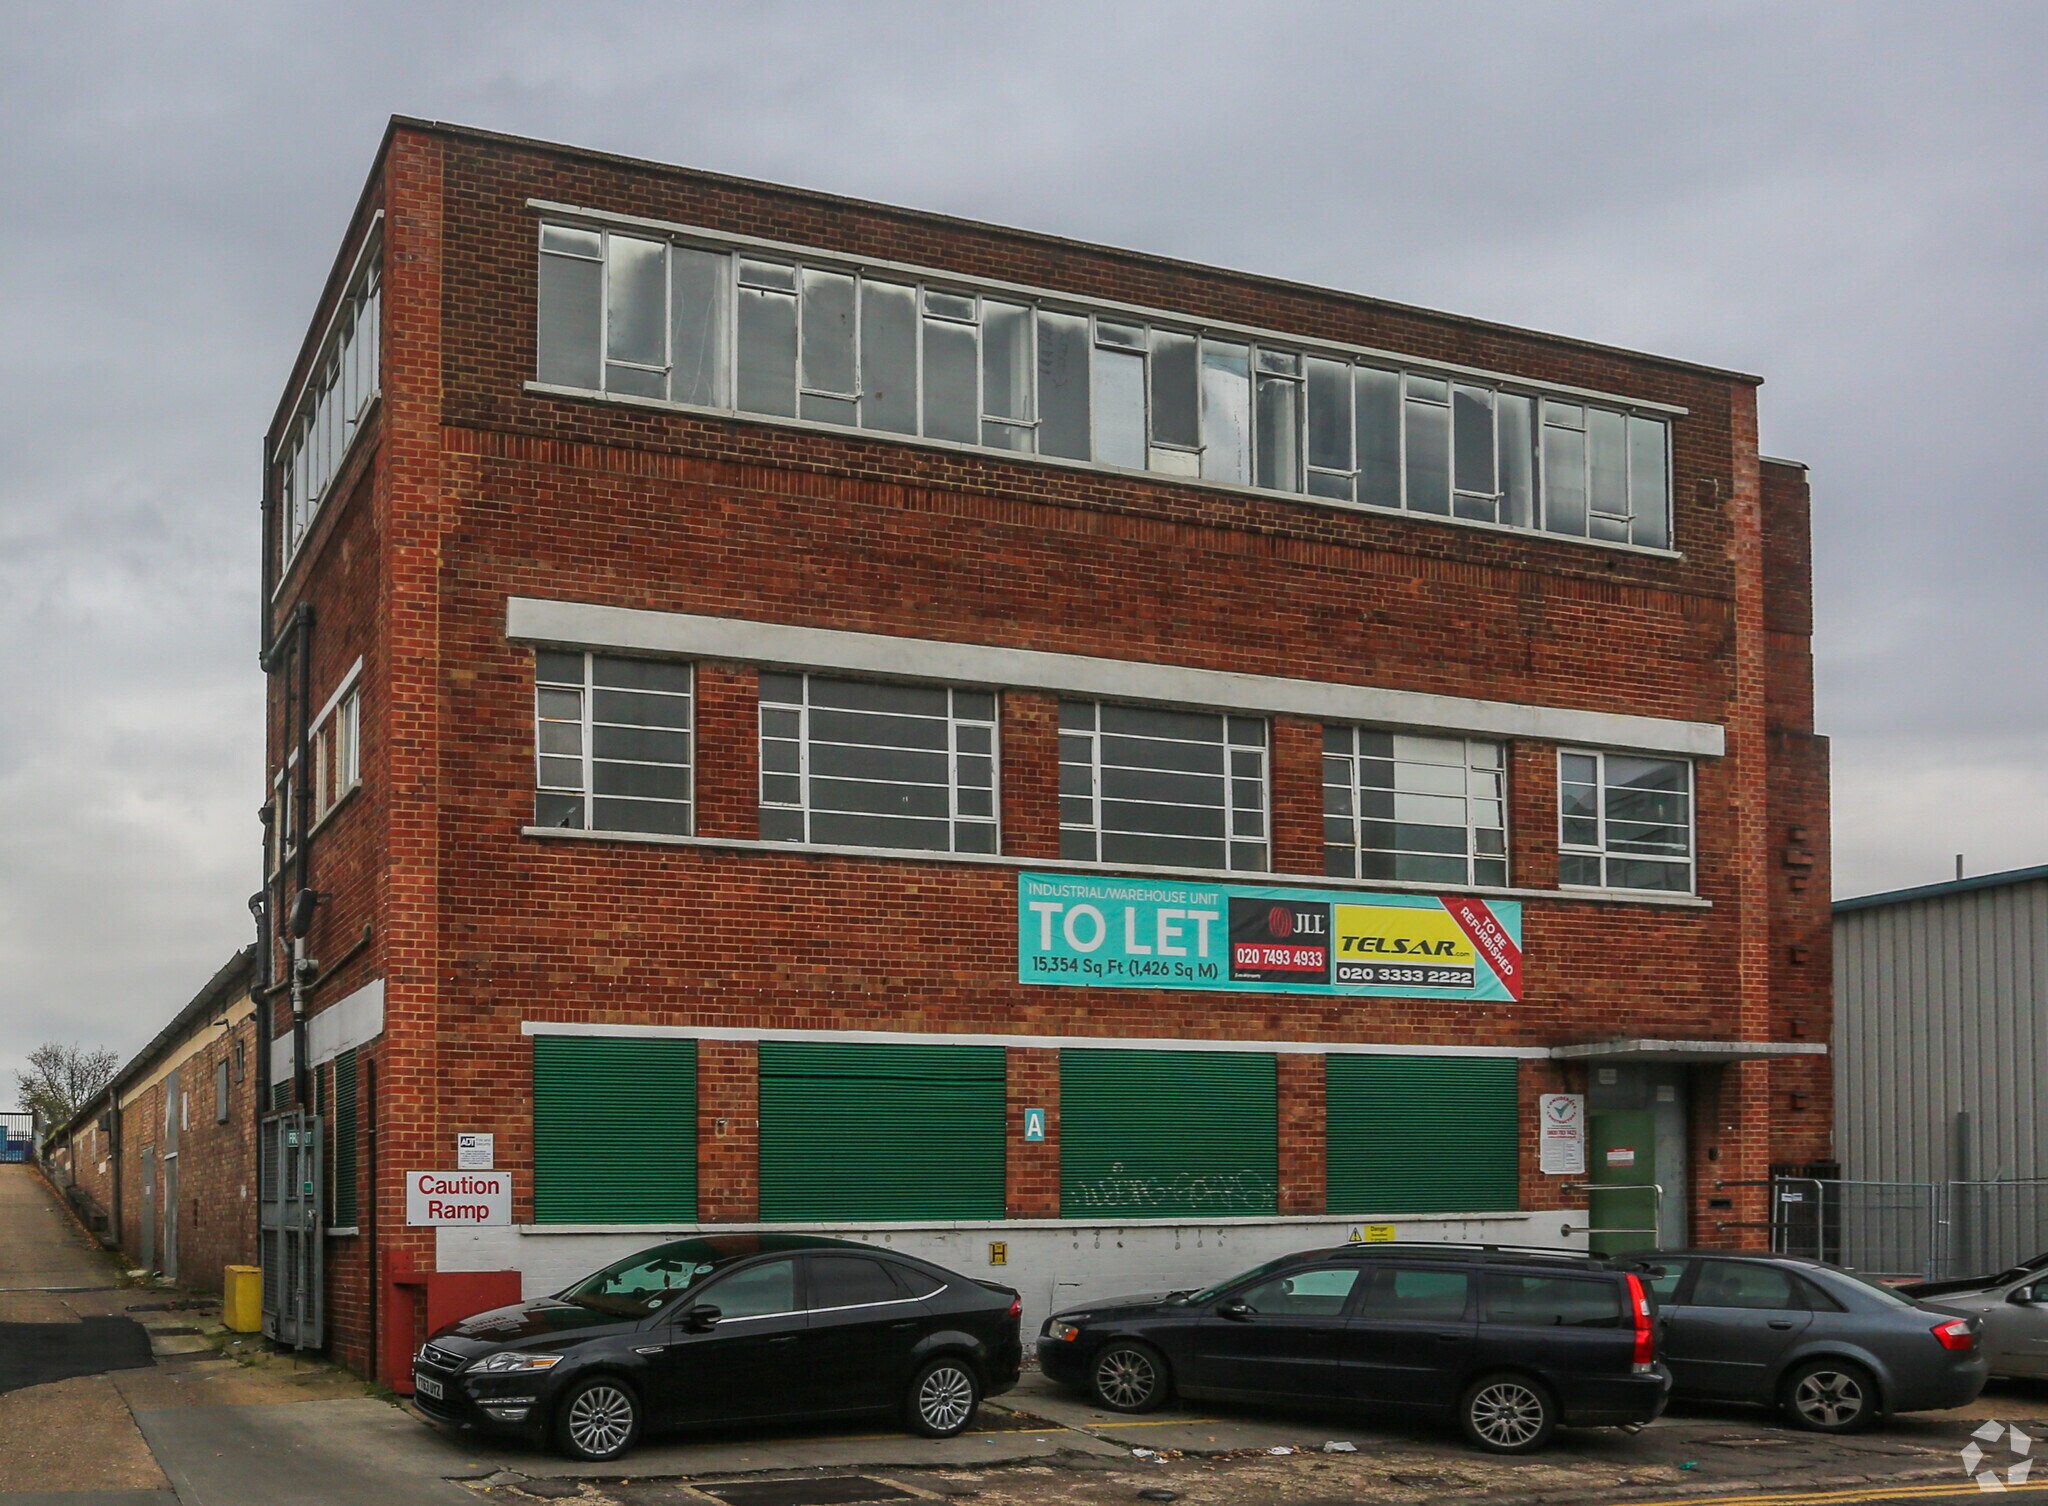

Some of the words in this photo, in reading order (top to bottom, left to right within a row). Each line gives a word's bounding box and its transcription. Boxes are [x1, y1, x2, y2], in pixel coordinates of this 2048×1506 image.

[1028, 882, 1187, 904] INDUSTRIAL/WAREHOUSE
[1190, 892, 1219, 905] UNIT
[1029, 901, 1106, 953] TO
[1124, 906, 1219, 957] LET
[1293, 913, 1325, 934] JLL
[1482, 916, 1496, 934] TO
[1493, 932, 1508, 950] BE
[1460, 906, 1514, 976] REFURBISHED
[1032, 956, 1078, 973] 15,354
[1083, 958, 1102, 977] Sq
[1108, 960, 1123, 974] Ft
[1129, 959, 1170, 977] (1,426
[1174, 962, 1193, 980] Sq
[1199, 963, 1218, 979] M)
[1237, 948, 1259, 964] 020
[1263, 949, 1290, 965] 7493
[1293, 950, 1323, 966] 4933
[1338, 967, 1374, 980] 020
[1378, 968, 1424, 982] 3333
[1427, 971, 1472, 984] 2222
[1027, 1113, 1042, 1137] A
[461, 1138, 475, 1146] ADT
[418, 1175, 499, 1194] Caution
[428, 1200, 490, 1223] Ramp
[992, 1243, 1005, 1263] H
